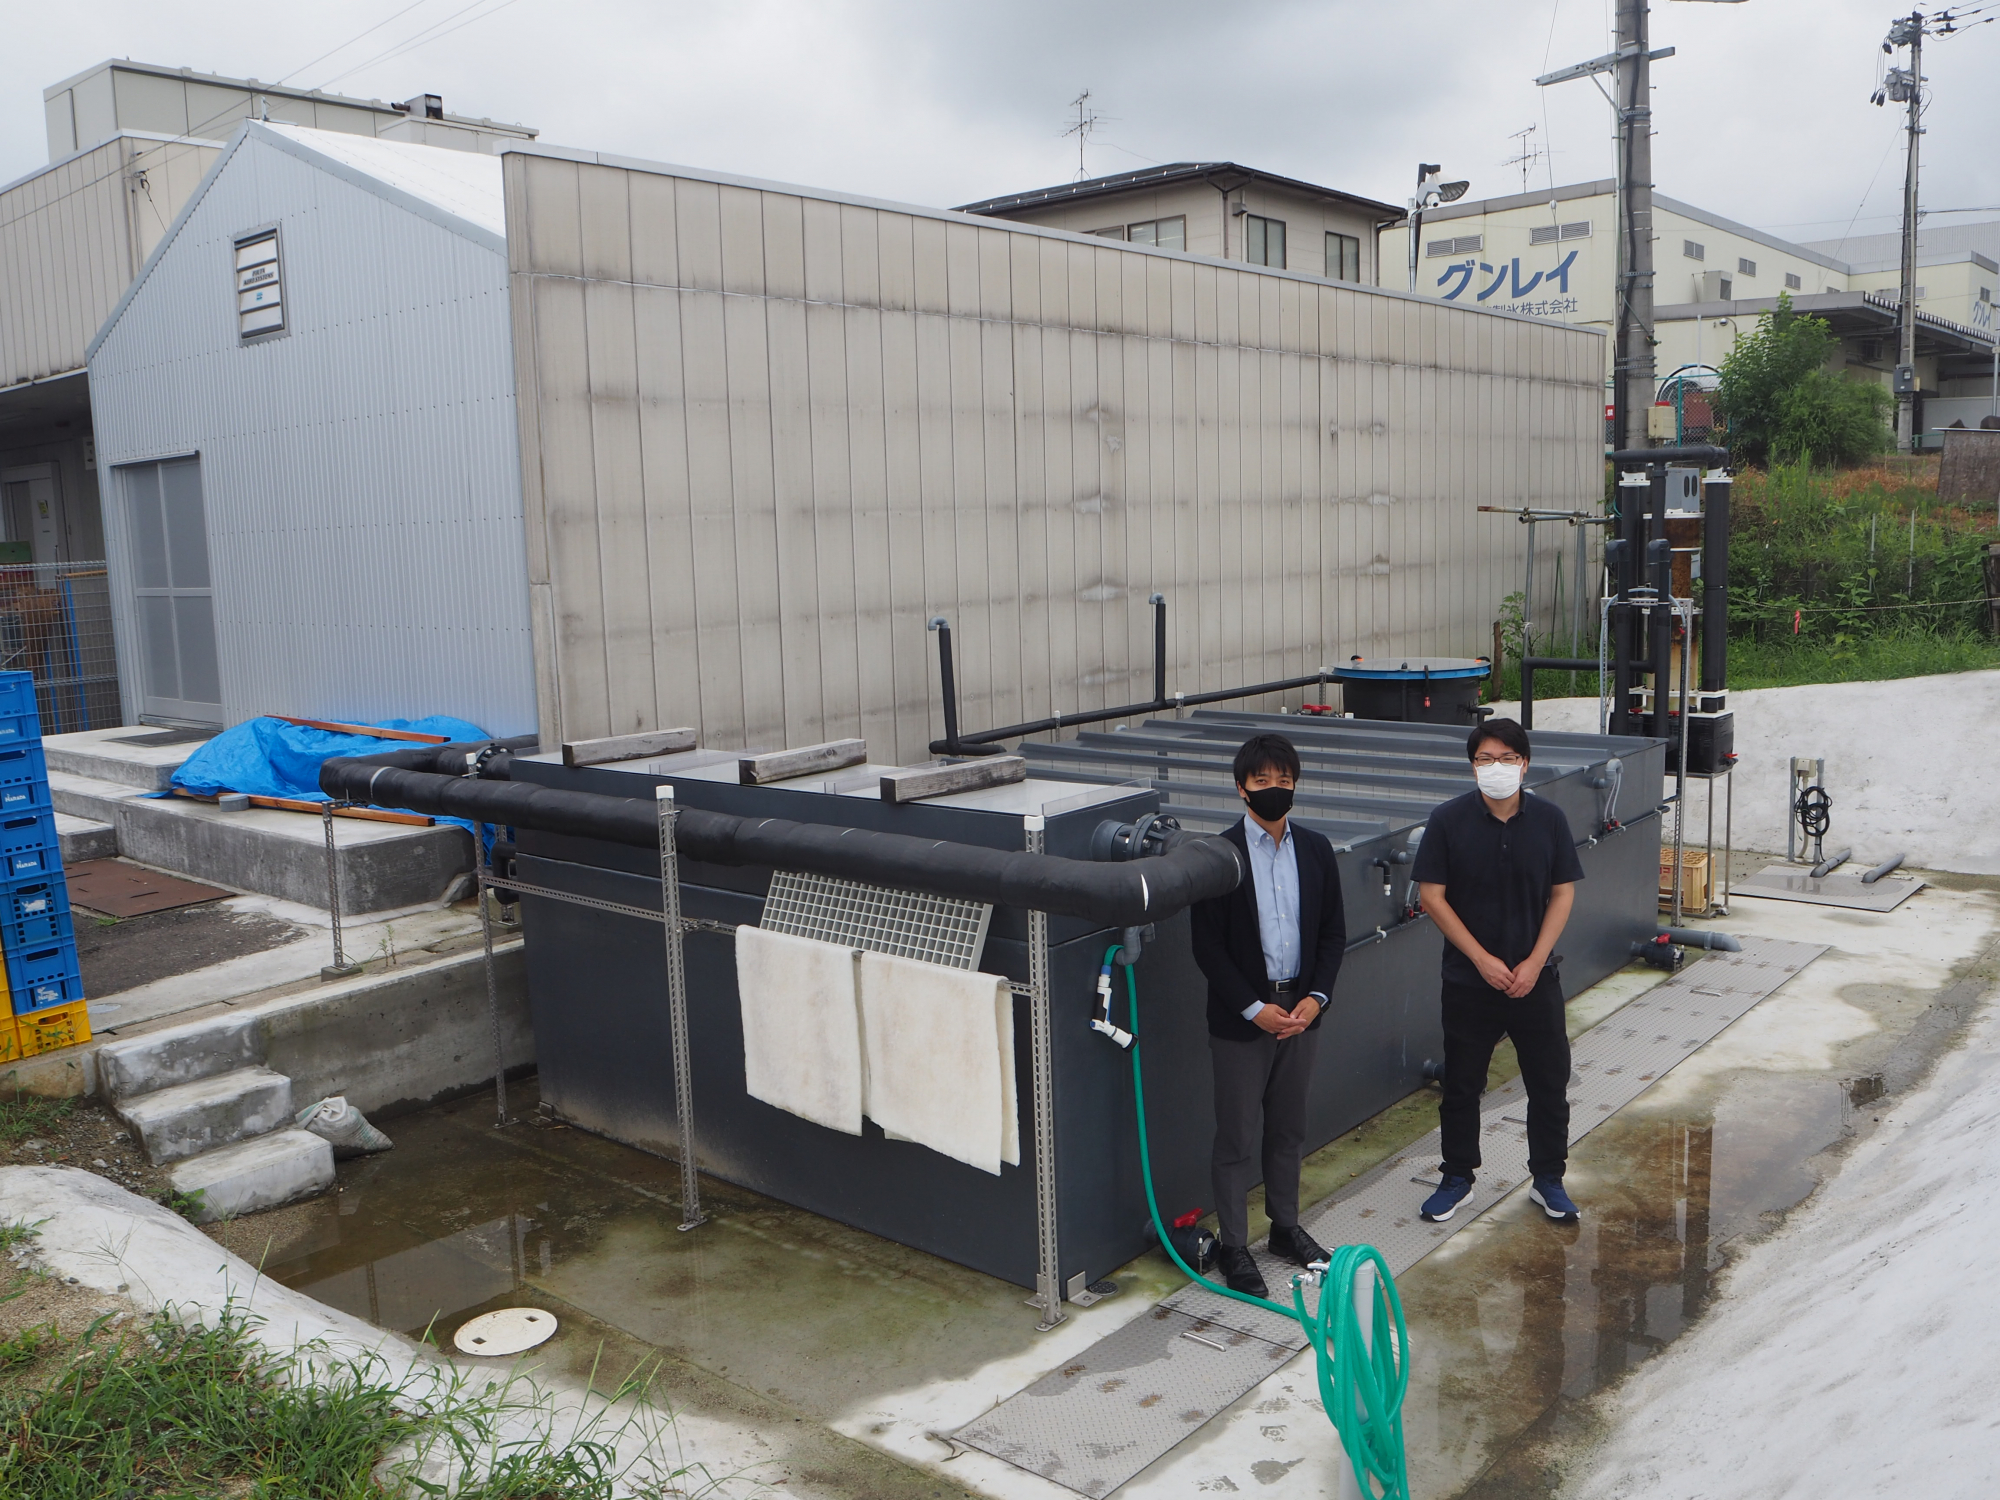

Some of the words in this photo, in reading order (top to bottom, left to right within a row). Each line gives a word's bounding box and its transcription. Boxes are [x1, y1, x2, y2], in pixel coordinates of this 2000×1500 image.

[1438, 251, 1578, 301] グンレイ
[1486, 297, 1578, 316] 氷株式会社
